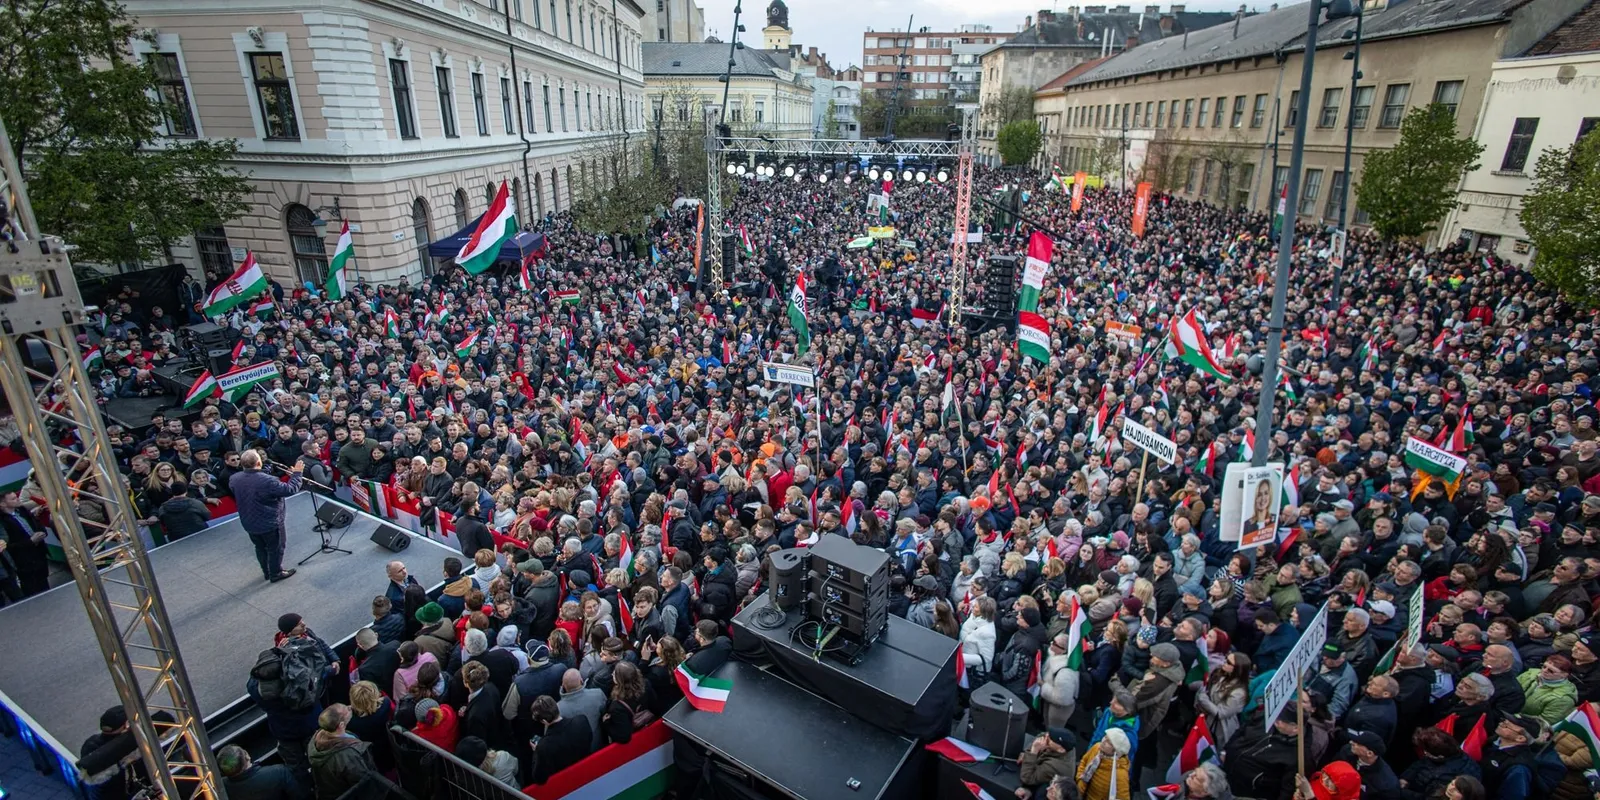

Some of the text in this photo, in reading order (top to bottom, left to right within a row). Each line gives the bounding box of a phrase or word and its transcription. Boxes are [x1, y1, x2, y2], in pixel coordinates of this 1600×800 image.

[221, 365, 275, 387] Berettyóújfalu
[780, 372, 811, 383] DERECSKE
[1124, 424, 1174, 460] HAJDÚSÁMSON
[1411, 440, 1457, 469] MARGITTA
